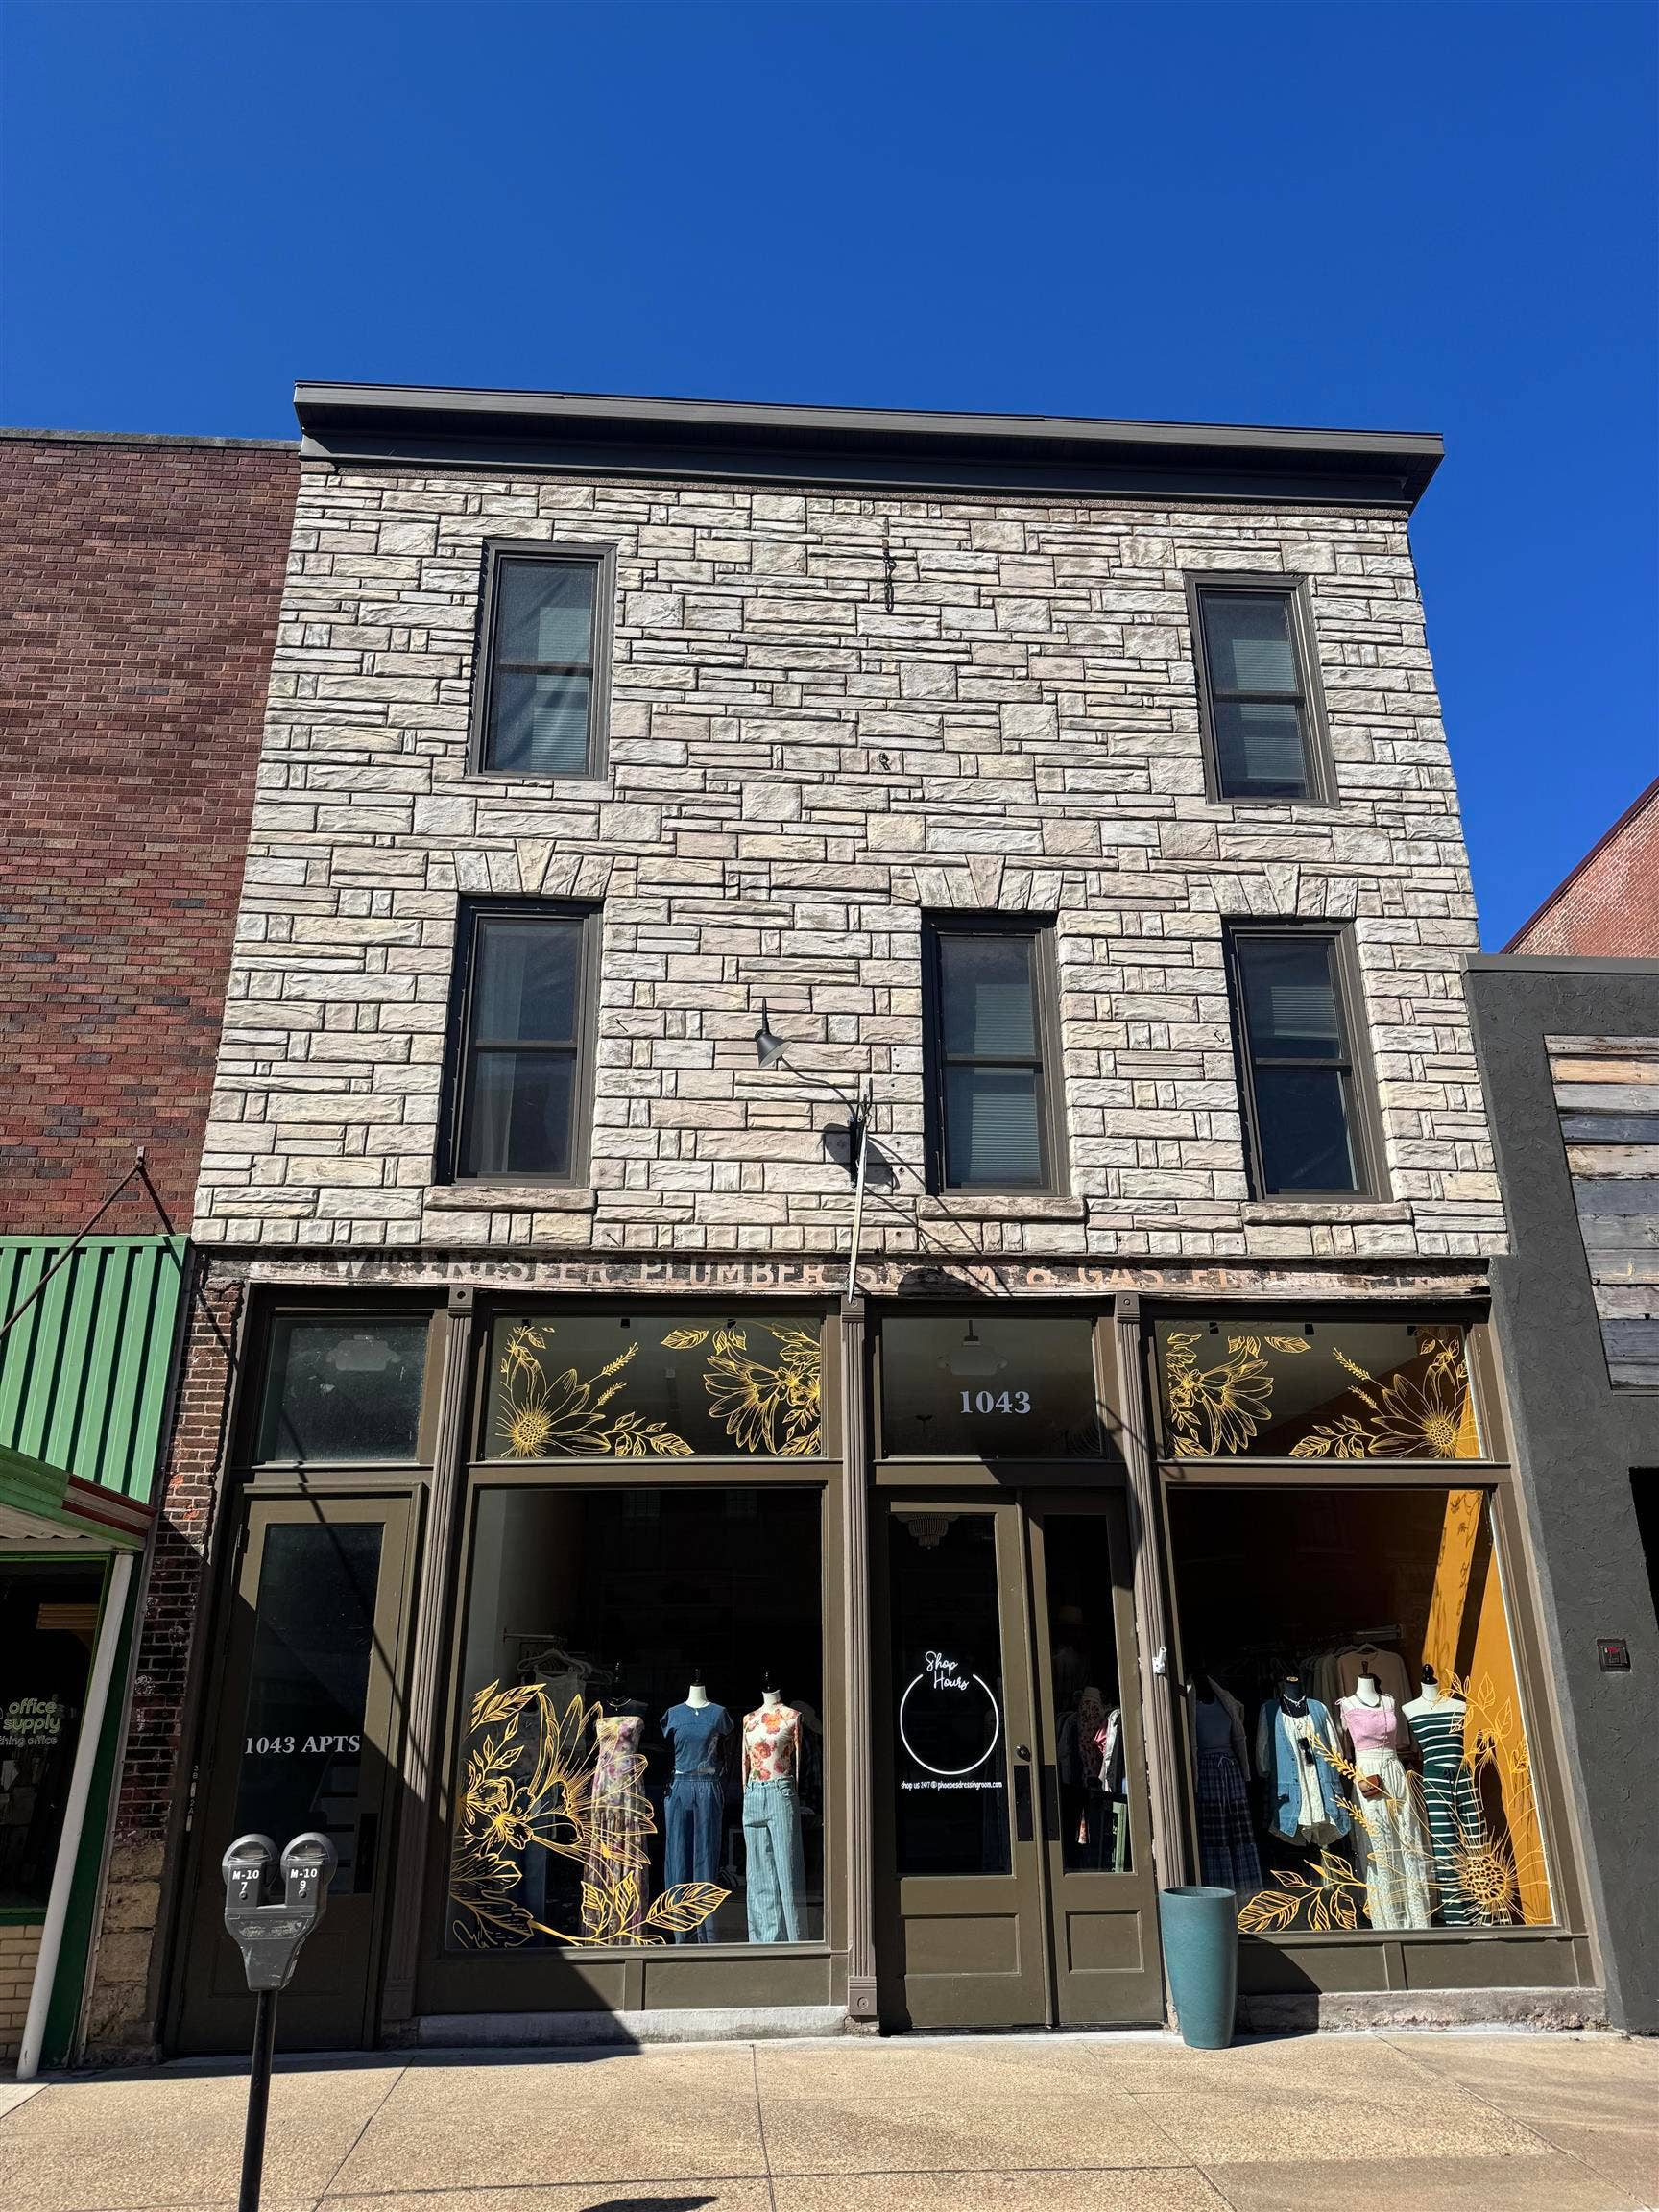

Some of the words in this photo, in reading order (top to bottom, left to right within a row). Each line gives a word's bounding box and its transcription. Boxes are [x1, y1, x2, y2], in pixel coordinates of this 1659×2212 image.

[960, 1390, 1031, 1414] 1043
[925, 1650, 959, 1676] Shop
[933, 1670, 970, 1691] Hours
[9, 1697, 58, 1715] office
[3, 1713, 61, 1734] supply
[28, 1735, 58, 1745] office
[244, 1736, 296, 1754] 1043
[301, 1734, 361, 1754] APTS
[901, 1780, 913, 1791] shop
[232, 1869, 260, 1881] M-10
[290, 1868, 318, 1880] M-10
[240, 1881, 248, 1891] 7
[299, 1880, 307, 1890] 9
